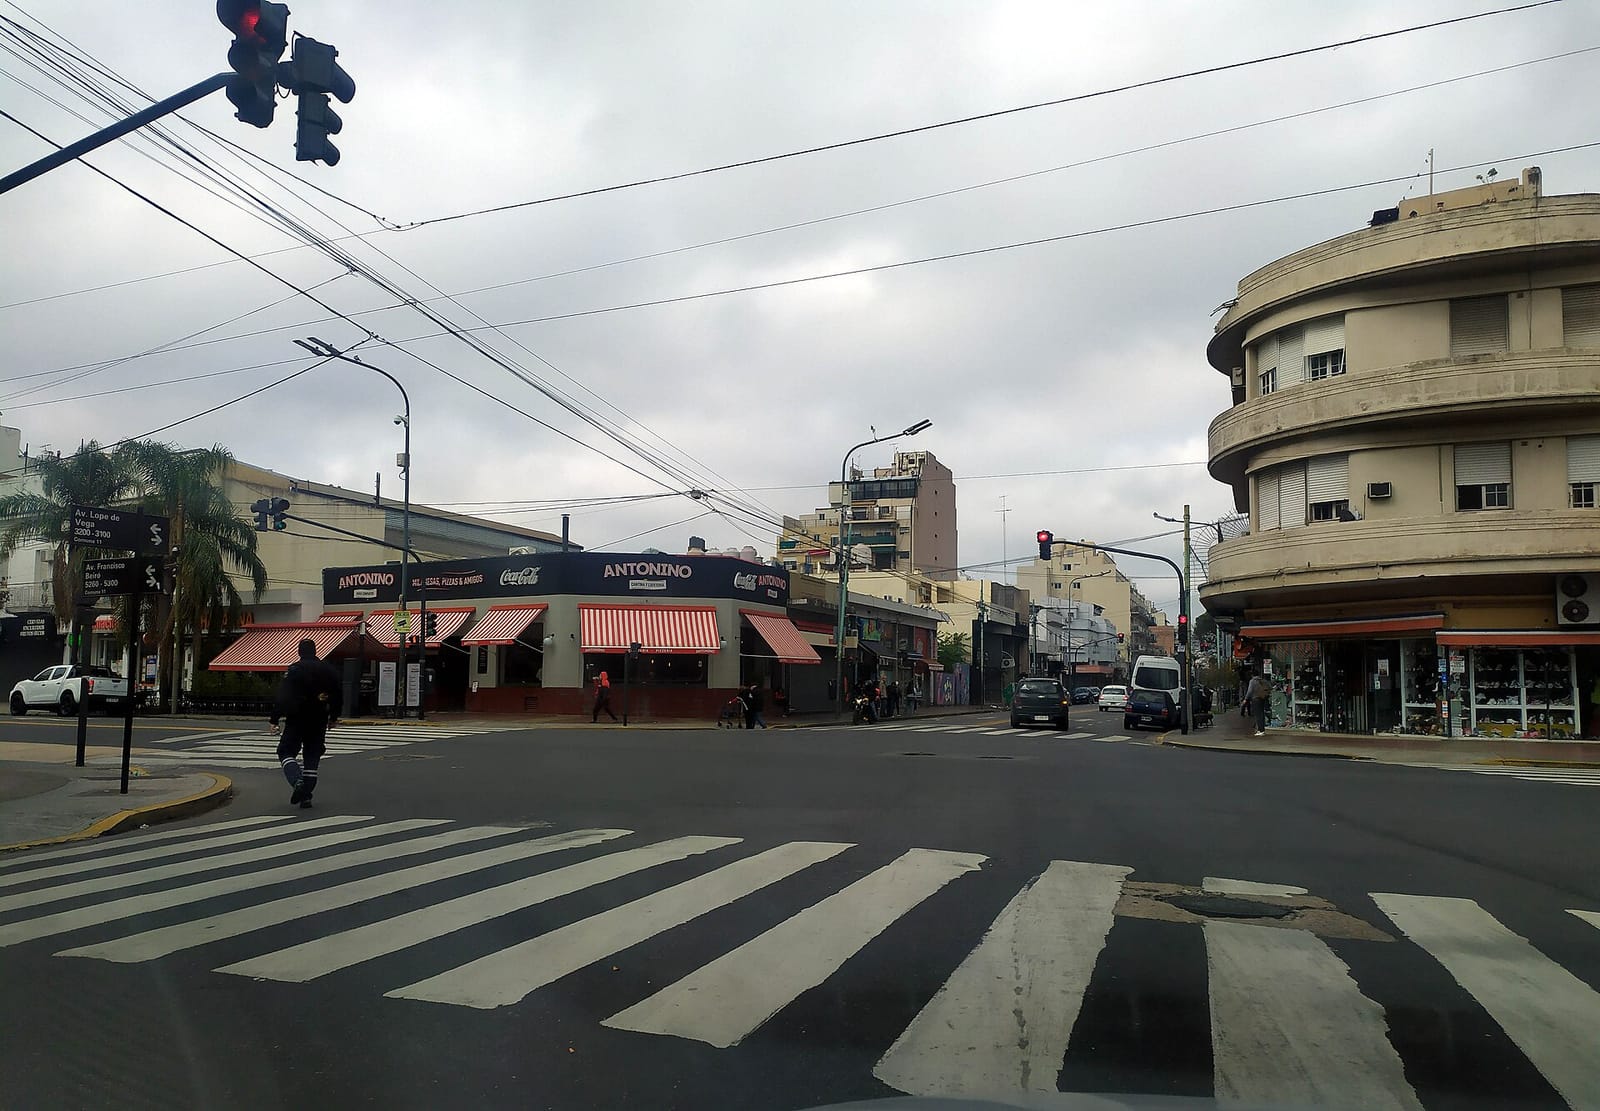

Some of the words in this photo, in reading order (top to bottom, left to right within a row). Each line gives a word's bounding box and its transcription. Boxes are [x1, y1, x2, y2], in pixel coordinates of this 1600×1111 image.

[75, 509, 88, 518] Av.
[90, 510, 109, 520] Lope
[110, 513, 120, 522] de
[75, 519, 95, 528] Vega
[74, 528, 91, 536] 3200
[95, 530, 111, 538] 3100
[97, 561, 126, 570] Francisco
[604, 562, 692, 578] ANTONINO
[339, 573, 394, 589] ANTONINO
[463, 574, 484, 585] AMIGOS
[758, 575, 787, 590] ANTONINO
